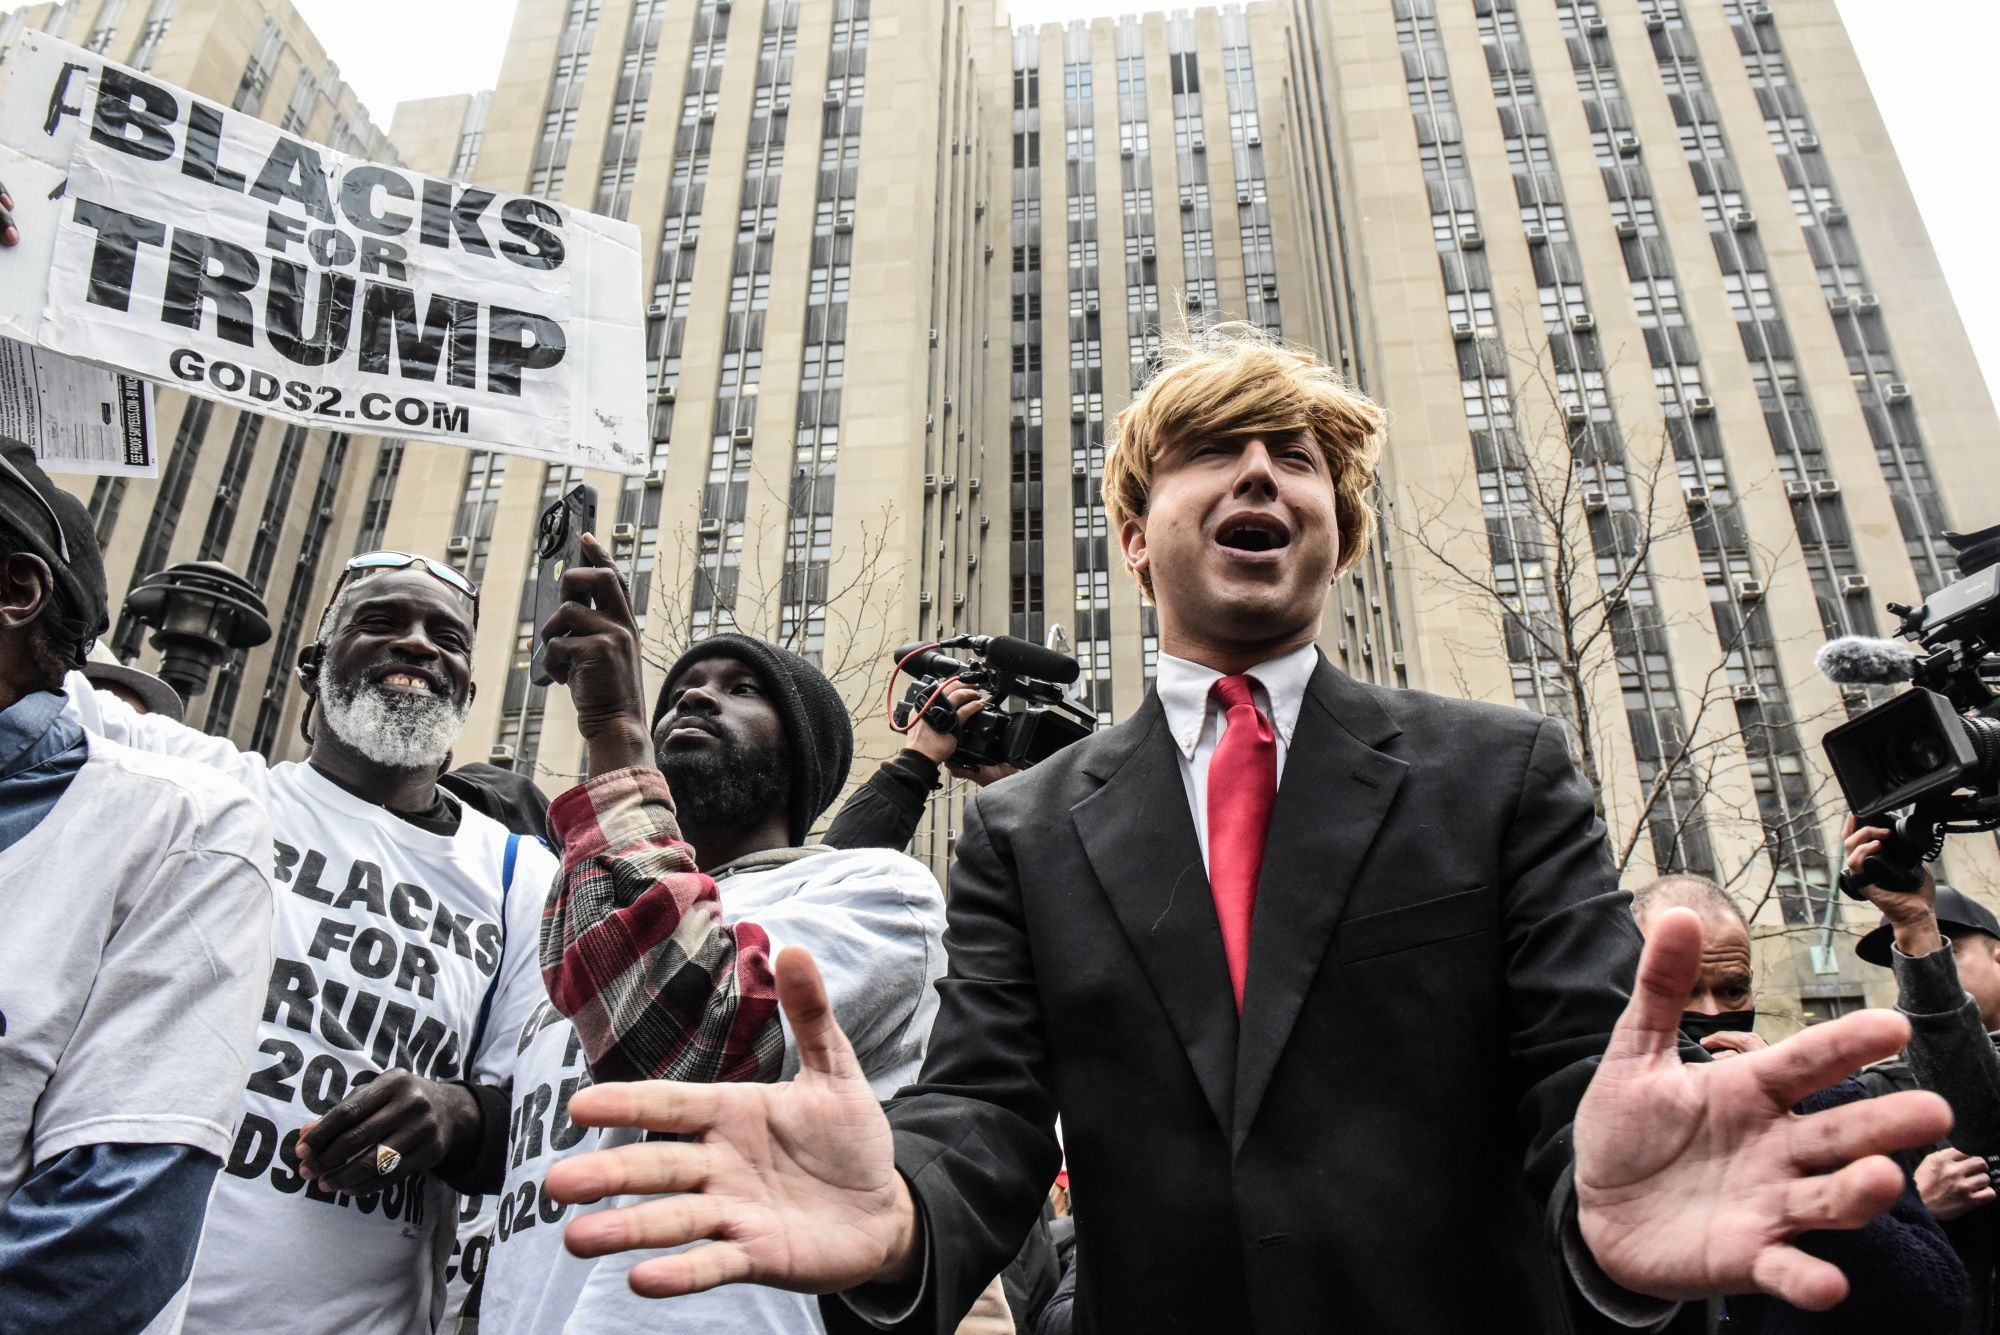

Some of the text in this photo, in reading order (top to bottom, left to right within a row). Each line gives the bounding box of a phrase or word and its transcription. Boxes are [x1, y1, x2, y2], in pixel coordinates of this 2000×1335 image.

[90, 65, 567, 271] BLACKS
[265, 210, 408, 281] FOR
[73, 198, 567, 397] TRUMP
[169, 348, 470, 433] GODS2.COM
[307, 917, 440, 1001] FOR
